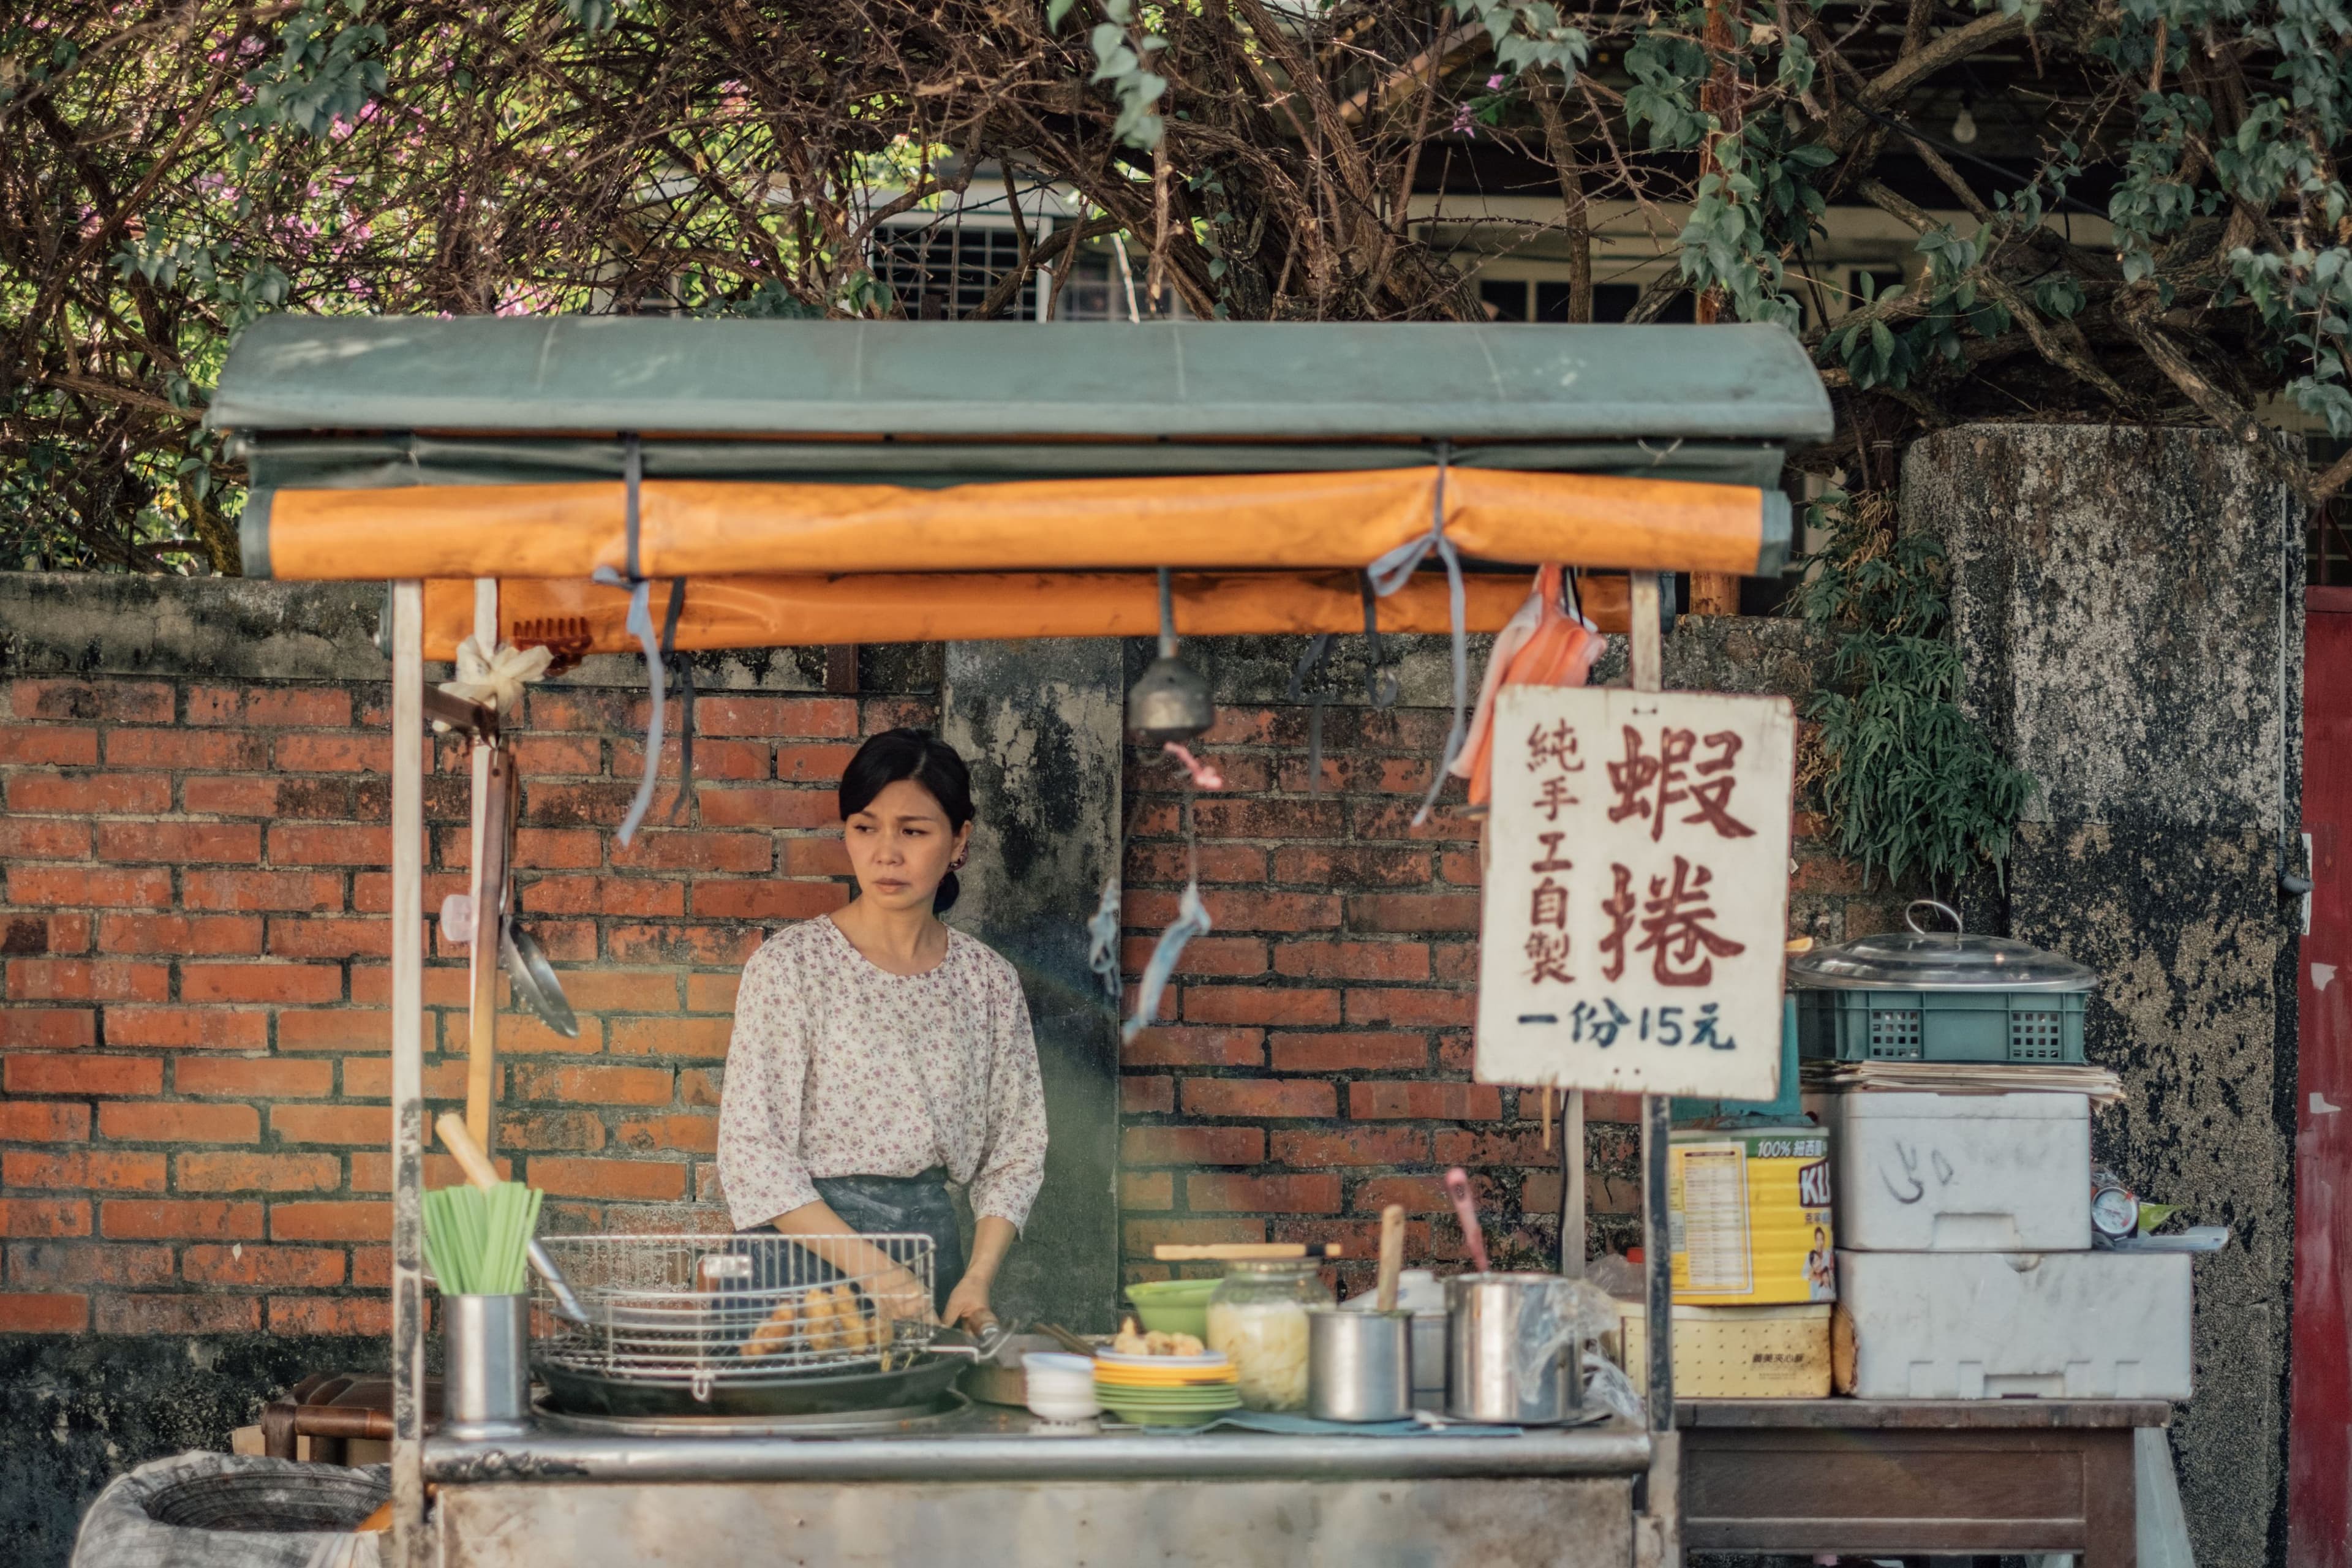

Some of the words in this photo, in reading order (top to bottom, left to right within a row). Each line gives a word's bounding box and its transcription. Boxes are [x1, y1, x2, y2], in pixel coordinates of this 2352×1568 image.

[1525, 718, 1585, 985] 純手工自製
[1598, 724, 1758, 988] 蝦捲
[1517, 997, 1737, 1051] 一份15元
[1758, 1140, 1791, 1157] 100%
